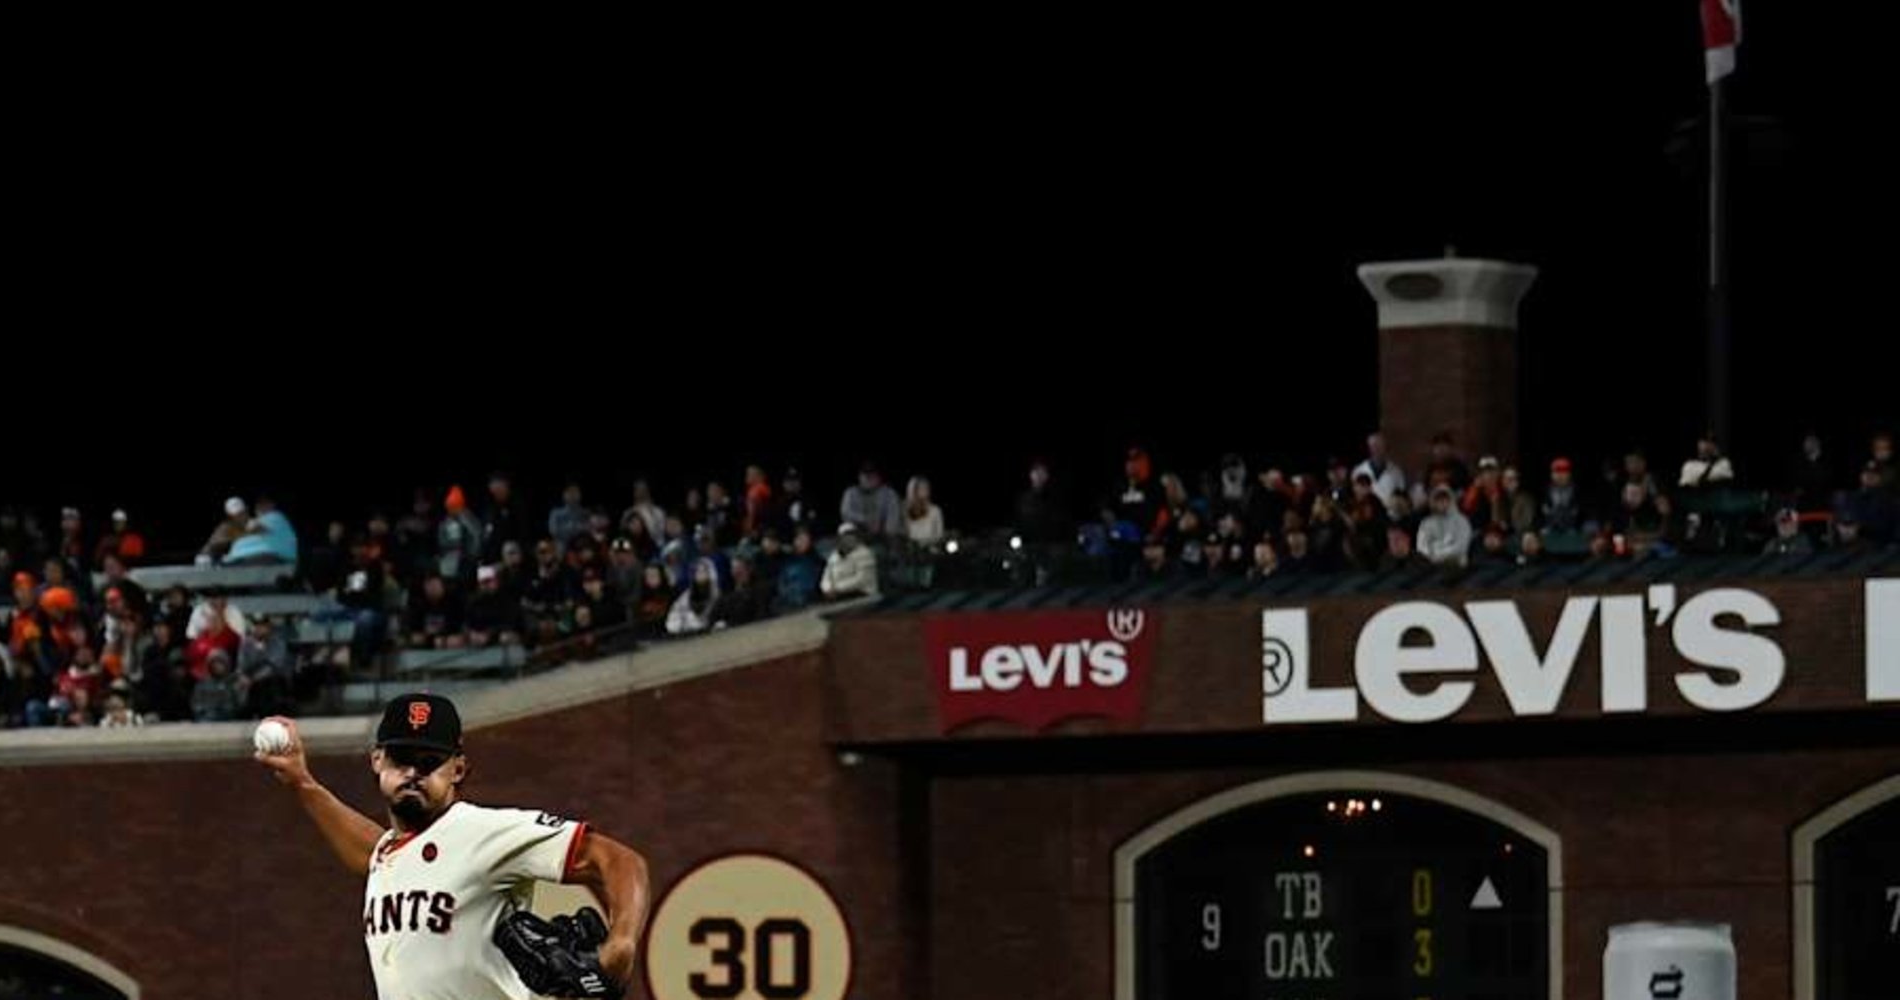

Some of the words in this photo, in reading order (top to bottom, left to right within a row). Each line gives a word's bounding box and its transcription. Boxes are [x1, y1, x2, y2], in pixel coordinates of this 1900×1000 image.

[1274, 871, 1323, 920] TB
[1201, 902, 1222, 951] 9
[688, 917, 812, 999] 30
[1264, 931, 1335, 979] OAK
[1412, 927, 1434, 977] 3
